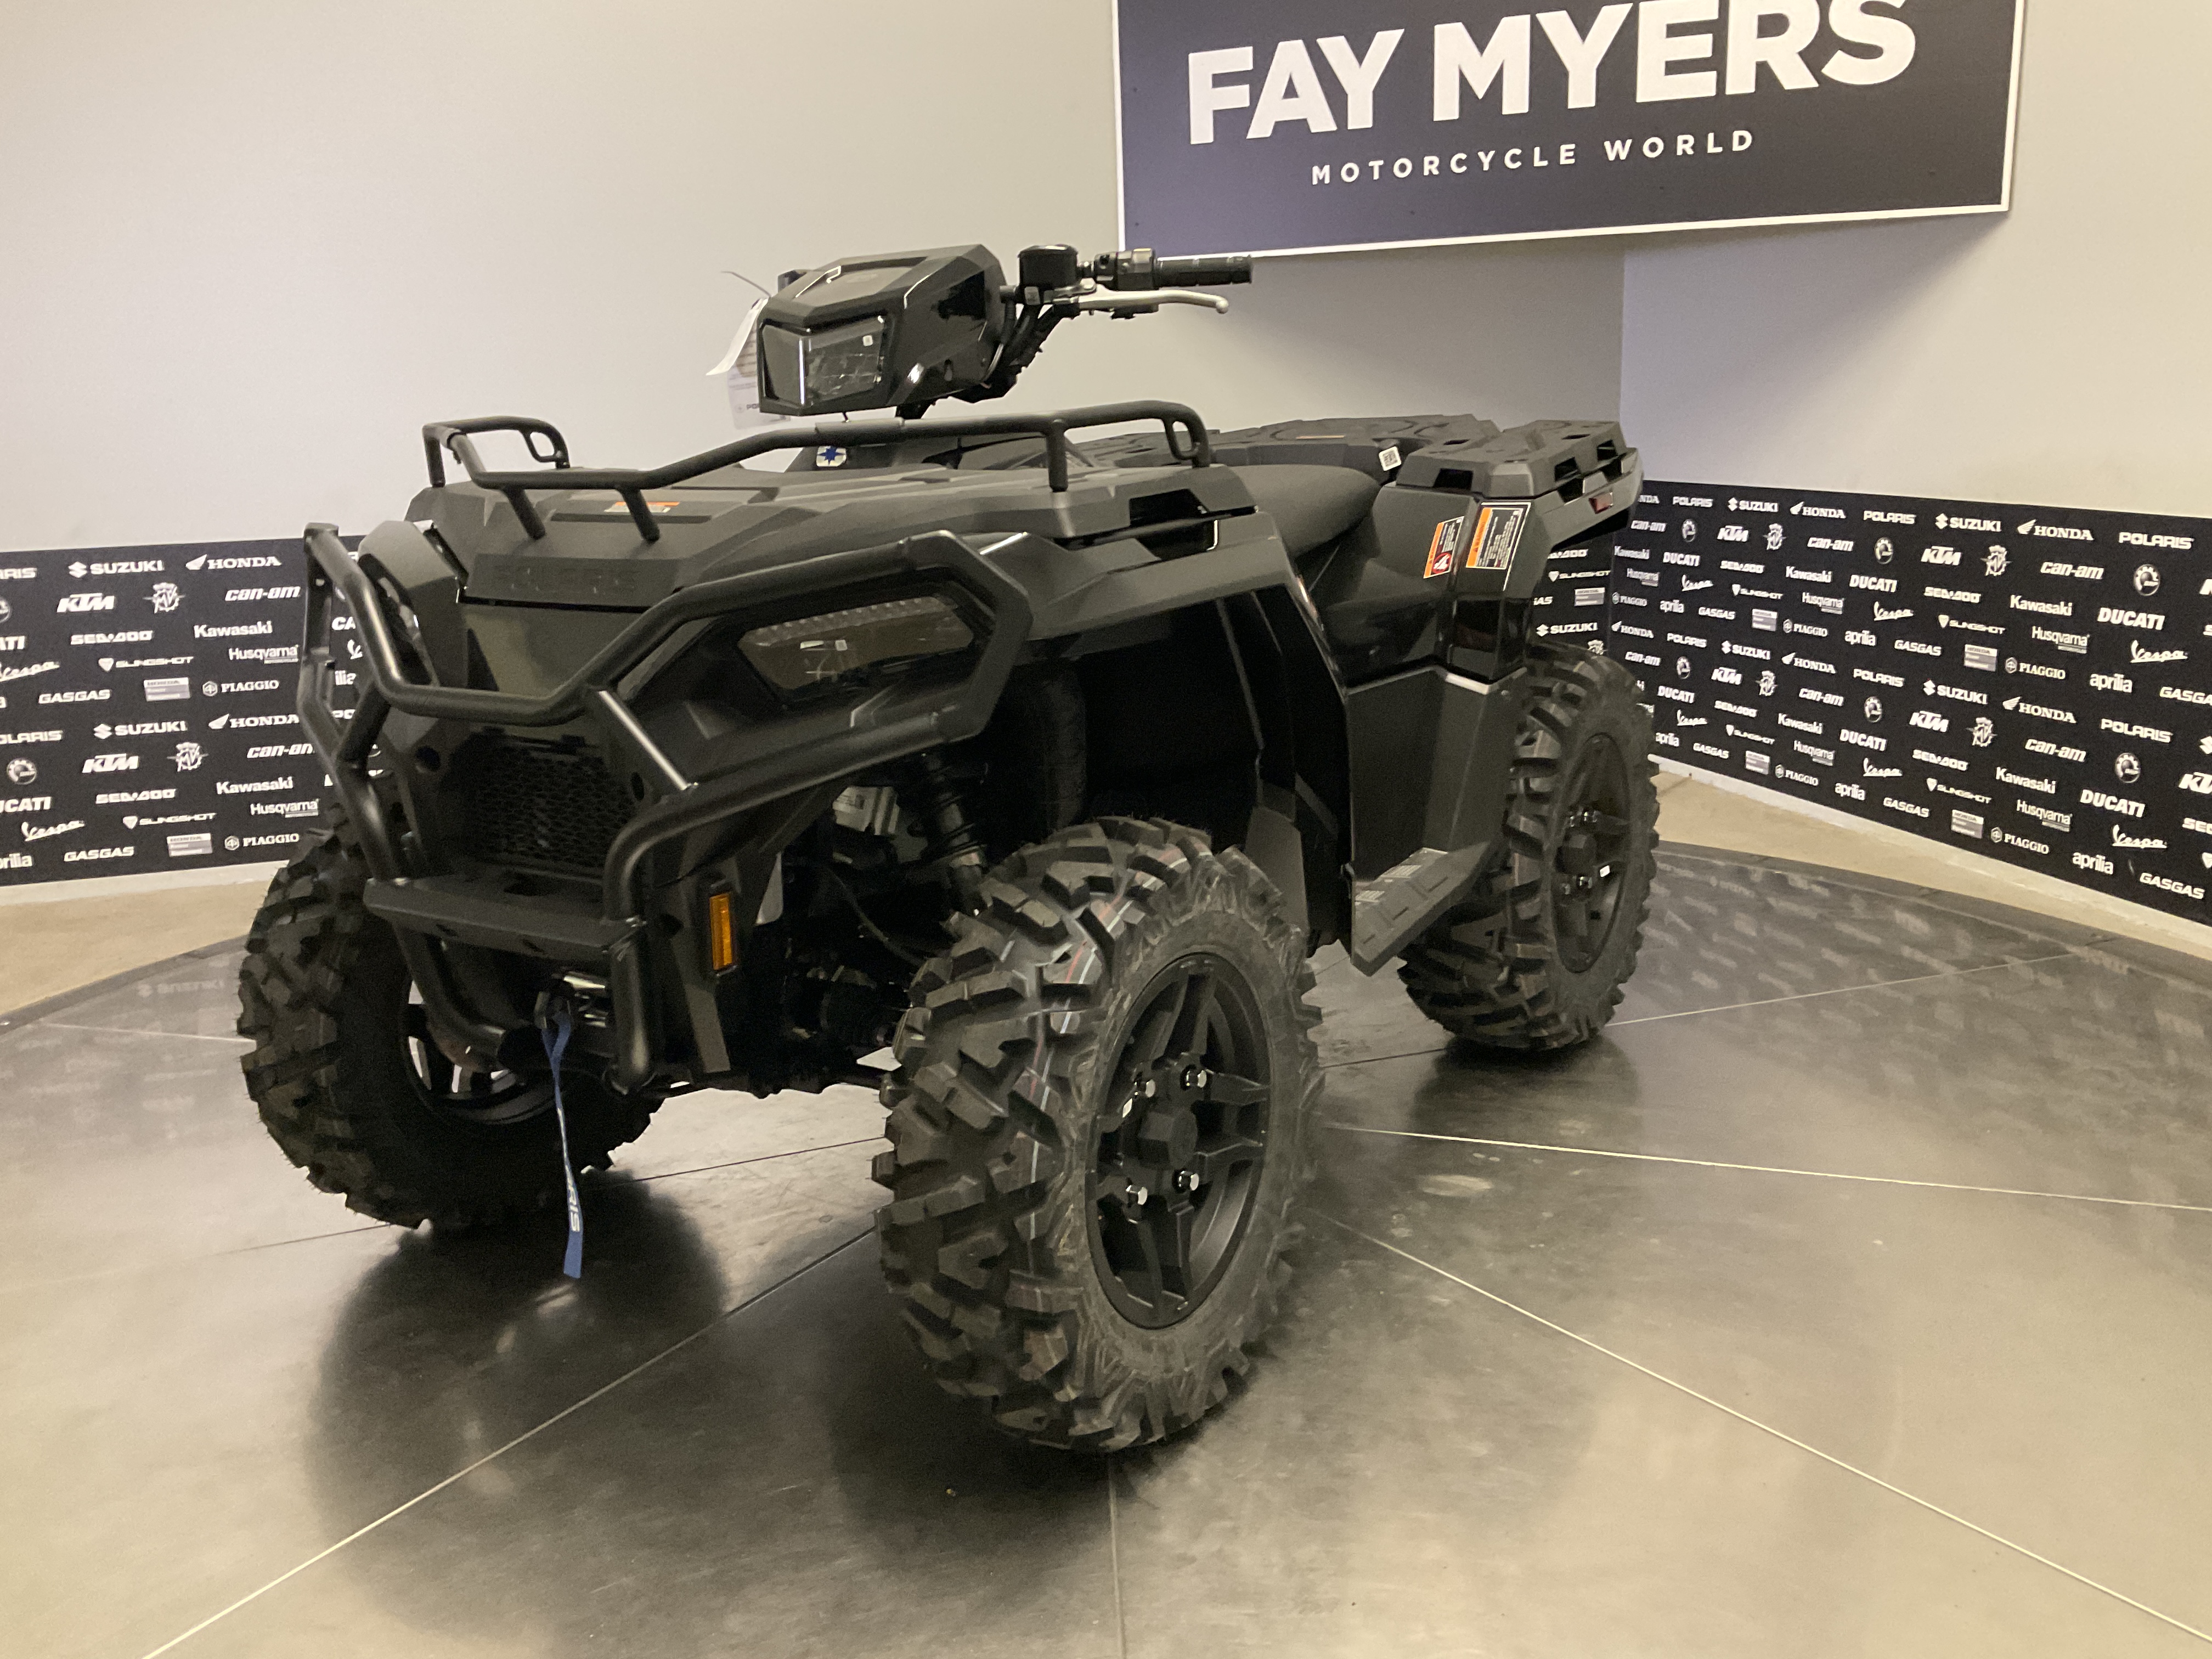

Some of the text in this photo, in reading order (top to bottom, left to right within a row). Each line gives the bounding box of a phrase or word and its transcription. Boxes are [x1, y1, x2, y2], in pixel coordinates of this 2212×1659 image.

[1188, 0, 1915, 144] FAY MYERS
[1312, 131, 1752, 185] MOTORCYCLE WORLD
[1638, 495, 1660, 504] NDA
[1673, 496, 1713, 507] POLARIS
[1739, 500, 1778, 512] SUZUKI
[1802, 507, 1846, 518] HONDA
[1864, 511, 1916, 524] POLARIS
[1949, 517, 2001, 532] SUZUKI
[2034, 526, 2094, 540] HONDA
[1717, 526, 1748, 541] KTM
[2119, 532, 2194, 549] POLARIS
[1615, 546, 1650, 559] Kawasaki
[1663, 552, 1700, 566] DUCATI
[1921, 546, 1961, 565] KTM
[91, 560, 165, 574] SUZUKI
[207, 556, 281, 569] HONDA
[2040, 562, 2104, 579] can-am
[1786, 566, 1832, 583] Kawasaki
[1849, 575, 1897, 592] DUCATI
[57, 592, 115, 612] KTM
[225, 586, 301, 601] can-am
[1620, 595, 1647, 606] PIAGGIO
[1874, 601, 1914, 620] Vespa
[2010, 595, 2072, 616] Kawasaki
[2097, 607, 2165, 630] DUCATI
[194, 621, 272, 638] Kawasaki
[1550, 623, 1598, 634] SUZUKI
[1621, 625, 1654, 638] HONDA
[1794, 624, 1828, 636] PIAGGIO
[2032, 625, 2090, 647] Husqvarna
[1667, 633, 1707, 647] POLARIS
[1845, 630, 1876, 646] aprilia
[229, 645, 298, 662] Husqvarna
[1733, 645, 1770, 660] SUZUKI
[1894, 640, 1942, 656] GASGAS
[2130, 640, 2187, 663] Vespa
[0, 662, 60, 682] espa
[1793, 658, 1836, 674] HONDA
[2019, 663, 2066, 679] PIAGGIO
[335, 670, 356, 685] ilia
[1711, 667, 1742, 685] KTM
[1854, 669, 1904, 687] POLARIS
[2090, 674, 2132, 693] aprilia
[221, 680, 279, 692] PIAGGIO
[1657, 686, 1695, 703] DUCATI
[1937, 685, 1988, 704] SUZUKI
[38, 690, 110, 703] GASGAS
[2160, 687, 2212, 706] GASGA
[229, 714, 300, 727] HONDA
[1909, 711, 1949, 732] KTM
[2019, 703, 2076, 723] HONDA
[115, 721, 188, 736] SUZUKI
[1778, 713, 1822, 734] Kawasaki
[2101, 719, 2173, 743] POLARIS
[0, 730, 63, 744] OLARIS
[1840, 729, 1886, 751] DUCATI
[2025, 739, 2086, 762] can-am
[82, 753, 138, 773] KTM
[1863, 758, 1902, 777] Vespa
[217, 776, 293, 794] Kawasaki
[1785, 770, 1818, 786] PIAGGIO
[1996, 767, 2056, 793] Kawasaki
[2179, 772, 2212, 794] KT
[0, 797, 51, 813] CATI
[250, 799, 319, 816] Husqvarna
[1883, 798, 1929, 817] GASGAS
[2080, 789, 2145, 817] DUCATI
[2017, 799, 2072, 826] Husqvarna
[21, 820, 84, 842] Vespa
[2112, 825, 2166, 849] Vespa
[243, 833, 299, 847] PIAGGIO
[2004, 834, 2049, 854] PIAGGIO
[0, 853, 32, 869] rilia
[64, 847, 134, 861] GASGAS
[2073, 853, 2113, 874] aprilia
[2140, 873, 2205, 899] GASGAS
